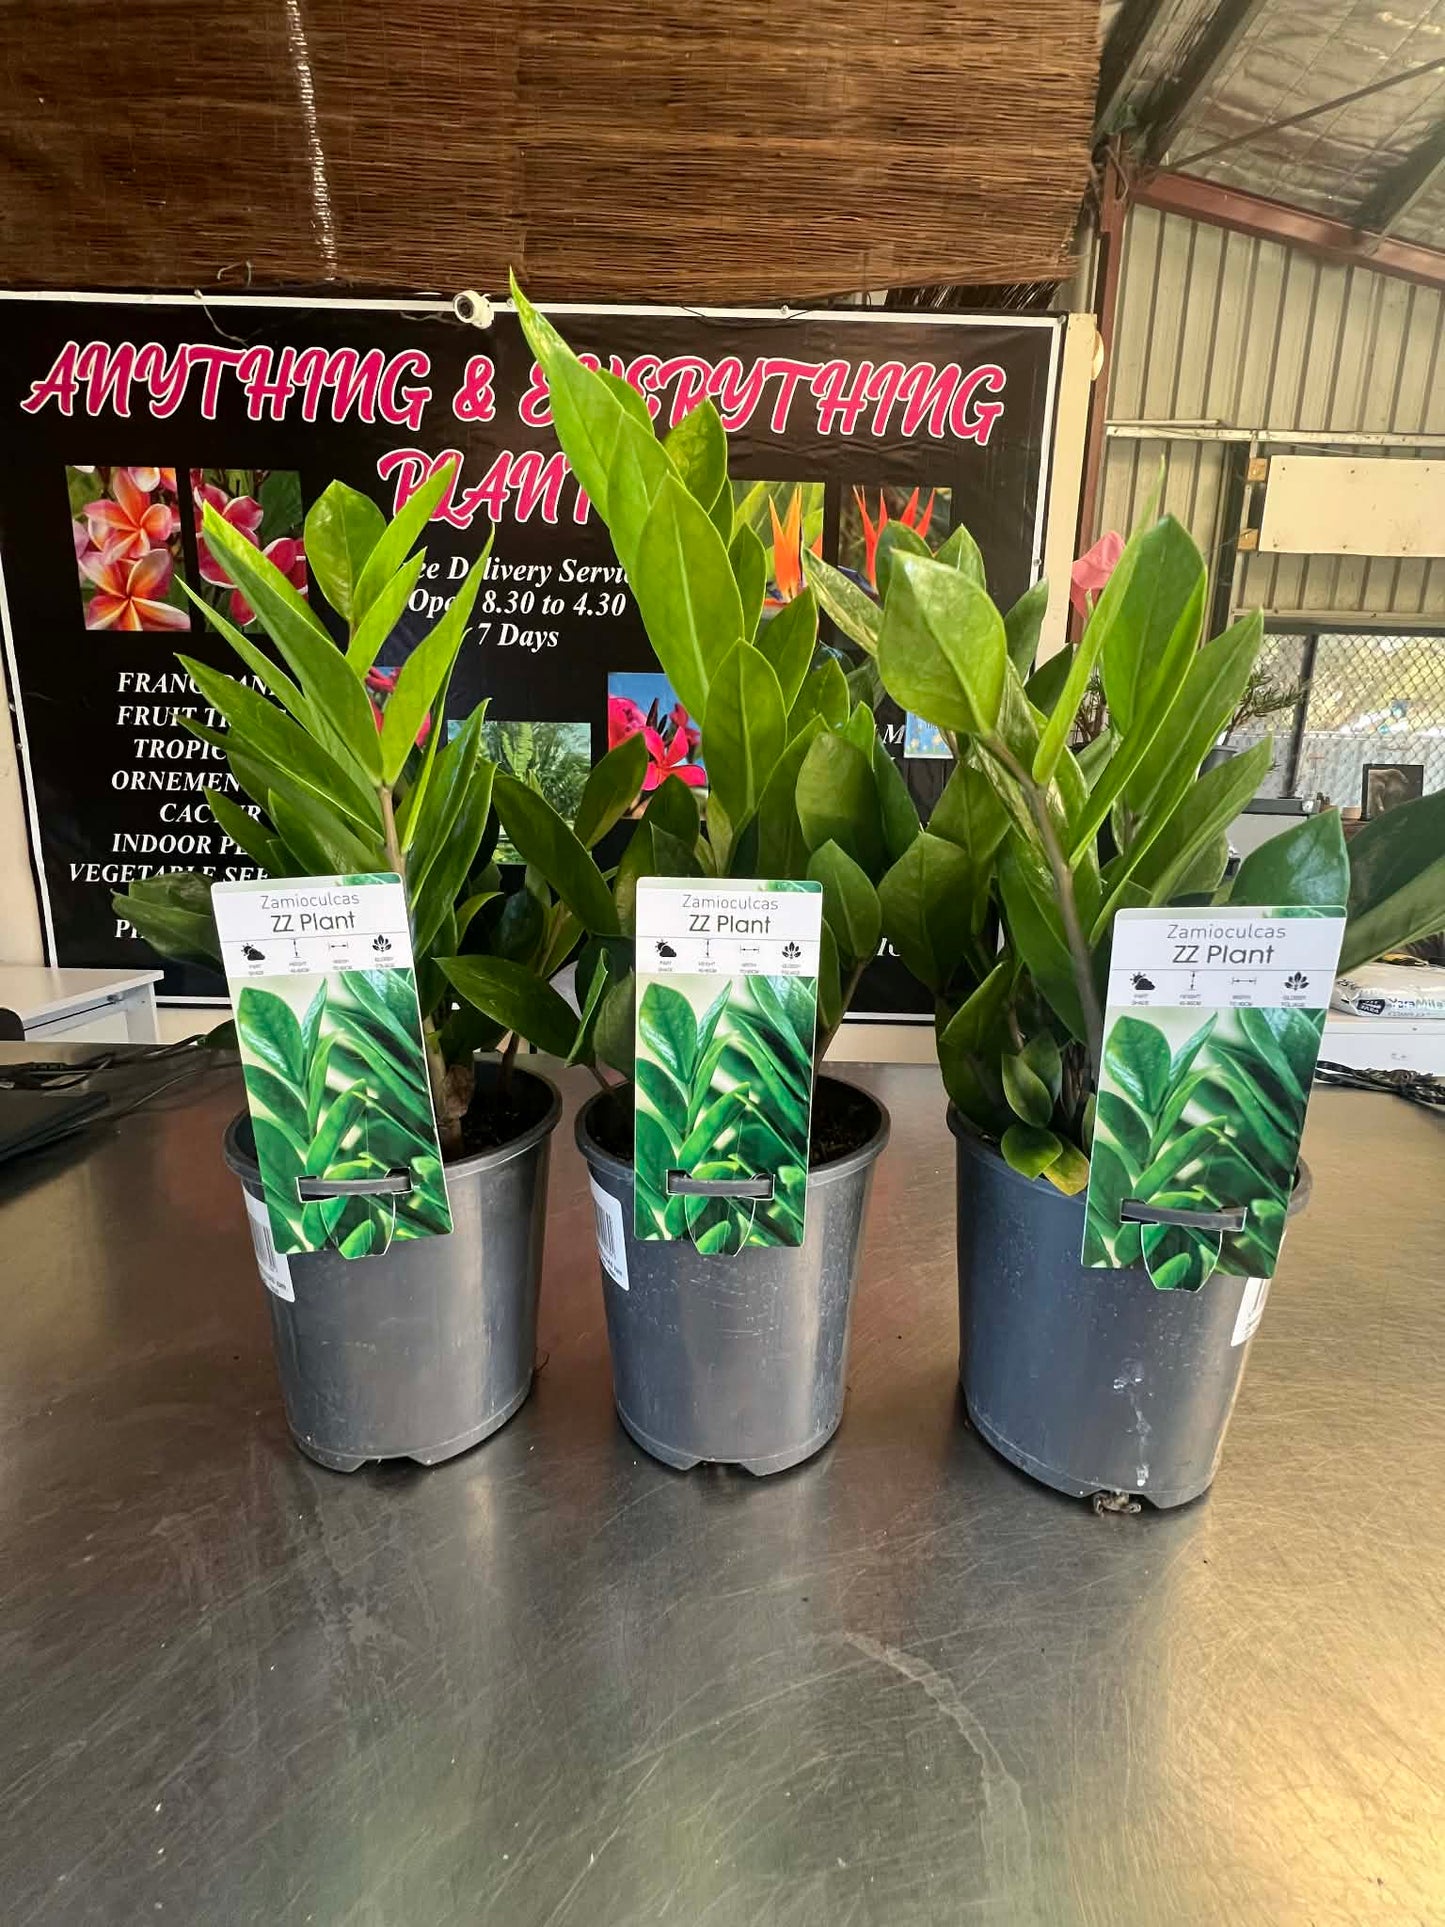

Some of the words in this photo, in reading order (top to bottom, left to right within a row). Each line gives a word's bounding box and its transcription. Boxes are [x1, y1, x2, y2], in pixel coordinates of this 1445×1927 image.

[20, 341, 431, 430] ANYTHING
[452, 354, 496, 422] &
[519, 353, 1007, 446] EERYTHING
[376, 448, 592, 529] PLAN
[446, 556, 552, 588] Dlivery
[558, 558, 629, 584] Servi
[481, 590, 535, 614] 8.30
[541, 596, 565, 616] to
[573, 592, 627, 617] 4.30
[478, 622, 492, 645] 7
[497, 622, 560, 653] Days
[116, 706, 197, 727] FRUIT
[133, 739, 227, 760] TROPIC
[111, 770, 241, 792] ORNEMEN
[112, 833, 212, 854] INDOOR
[260, 891, 360, 910] Zamioculcas
[682, 894, 779, 911] Zamioculcas
[270, 914, 294, 933] ZZ
[300, 911, 355, 932] Plant
[689, 914, 711, 932] ZZ
[717, 914, 771, 934] Plant
[1166, 923, 1287, 939] Zamioculcas
[1172, 944, 1200, 964] ZZ
[1206, 944, 1275, 964] Plant
